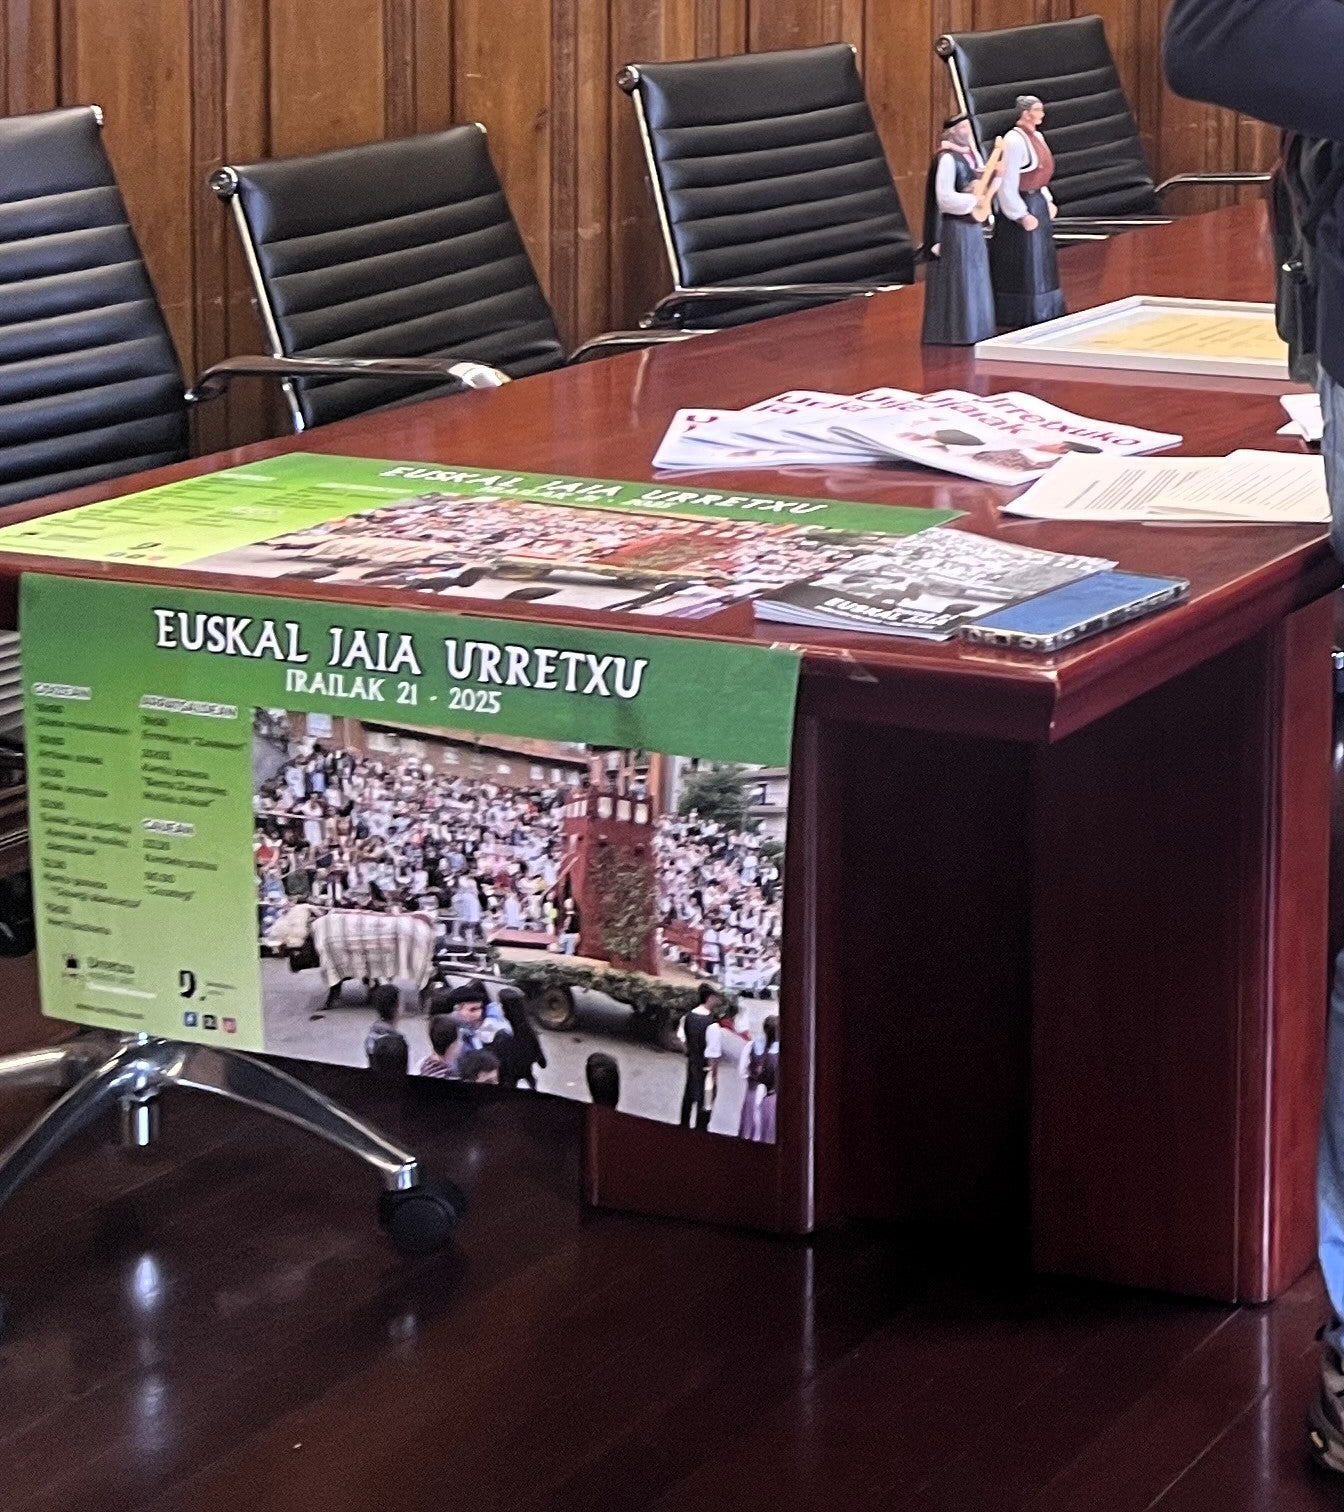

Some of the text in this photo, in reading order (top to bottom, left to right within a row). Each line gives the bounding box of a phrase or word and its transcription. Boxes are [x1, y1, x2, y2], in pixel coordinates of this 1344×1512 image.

[380, 466, 524, 488] EUSKAL
[641, 489, 828, 514] URRETXU
[152, 608, 649, 700] EUSKAL JAIA URRETXU
[285, 667, 385, 703] IRAILAK
[397, 685, 419, 707] 21
[448, 687, 502, 715] 2025
